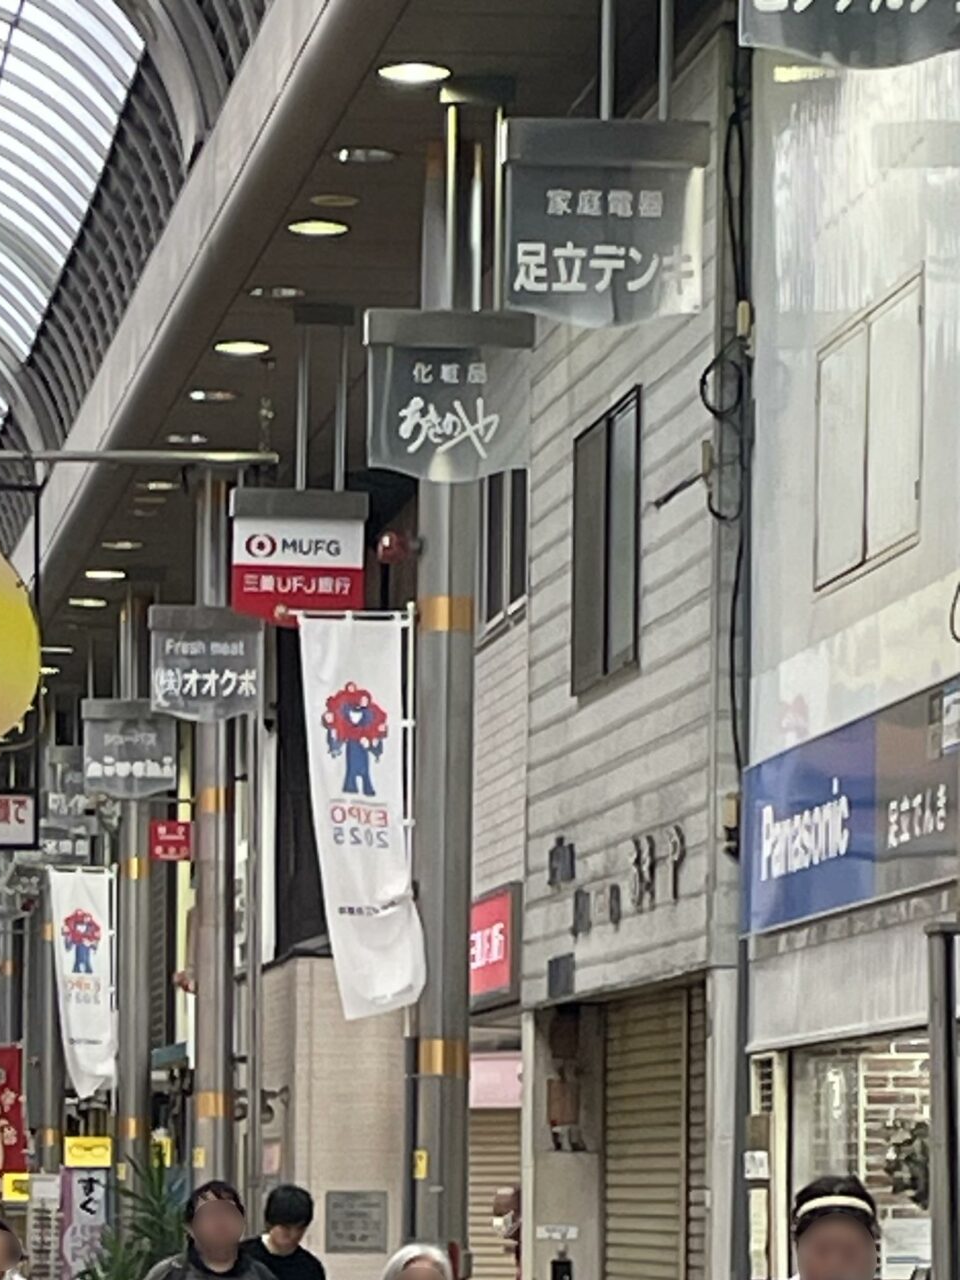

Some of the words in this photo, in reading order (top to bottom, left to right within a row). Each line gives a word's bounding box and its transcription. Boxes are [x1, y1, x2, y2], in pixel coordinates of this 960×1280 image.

[513, 241, 695, 295] 足立デンキ
[281, 538, 342, 556] MUFG
[761, 776, 849, 882] Panasonic
